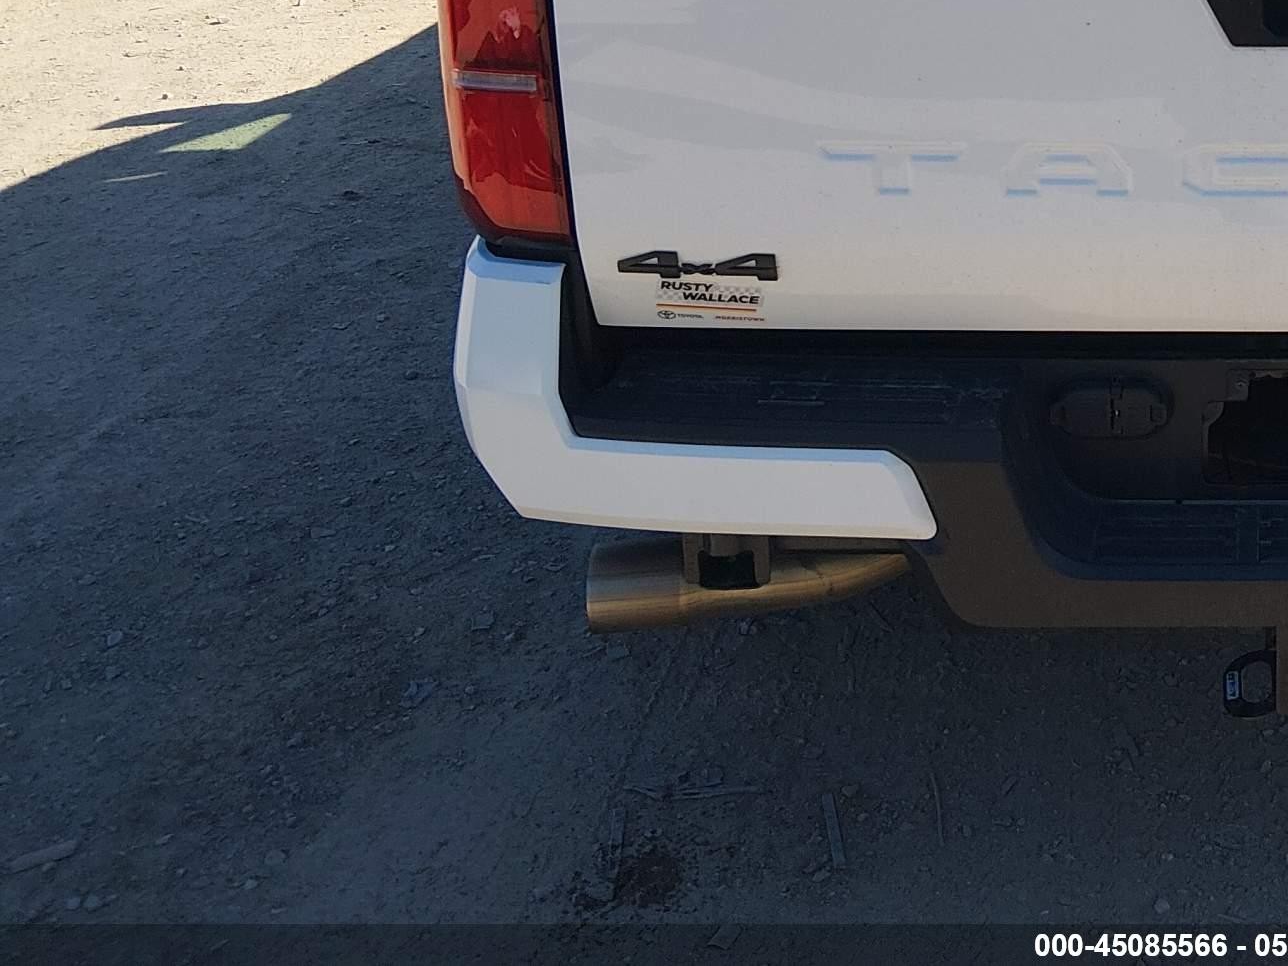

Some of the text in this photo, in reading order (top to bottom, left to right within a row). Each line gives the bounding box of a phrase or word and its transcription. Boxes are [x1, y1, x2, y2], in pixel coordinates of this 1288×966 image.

[617, 250, 778, 281] 4x4
[661, 281, 713, 292] RUSTY
[683, 292, 760, 305] WALLACE
